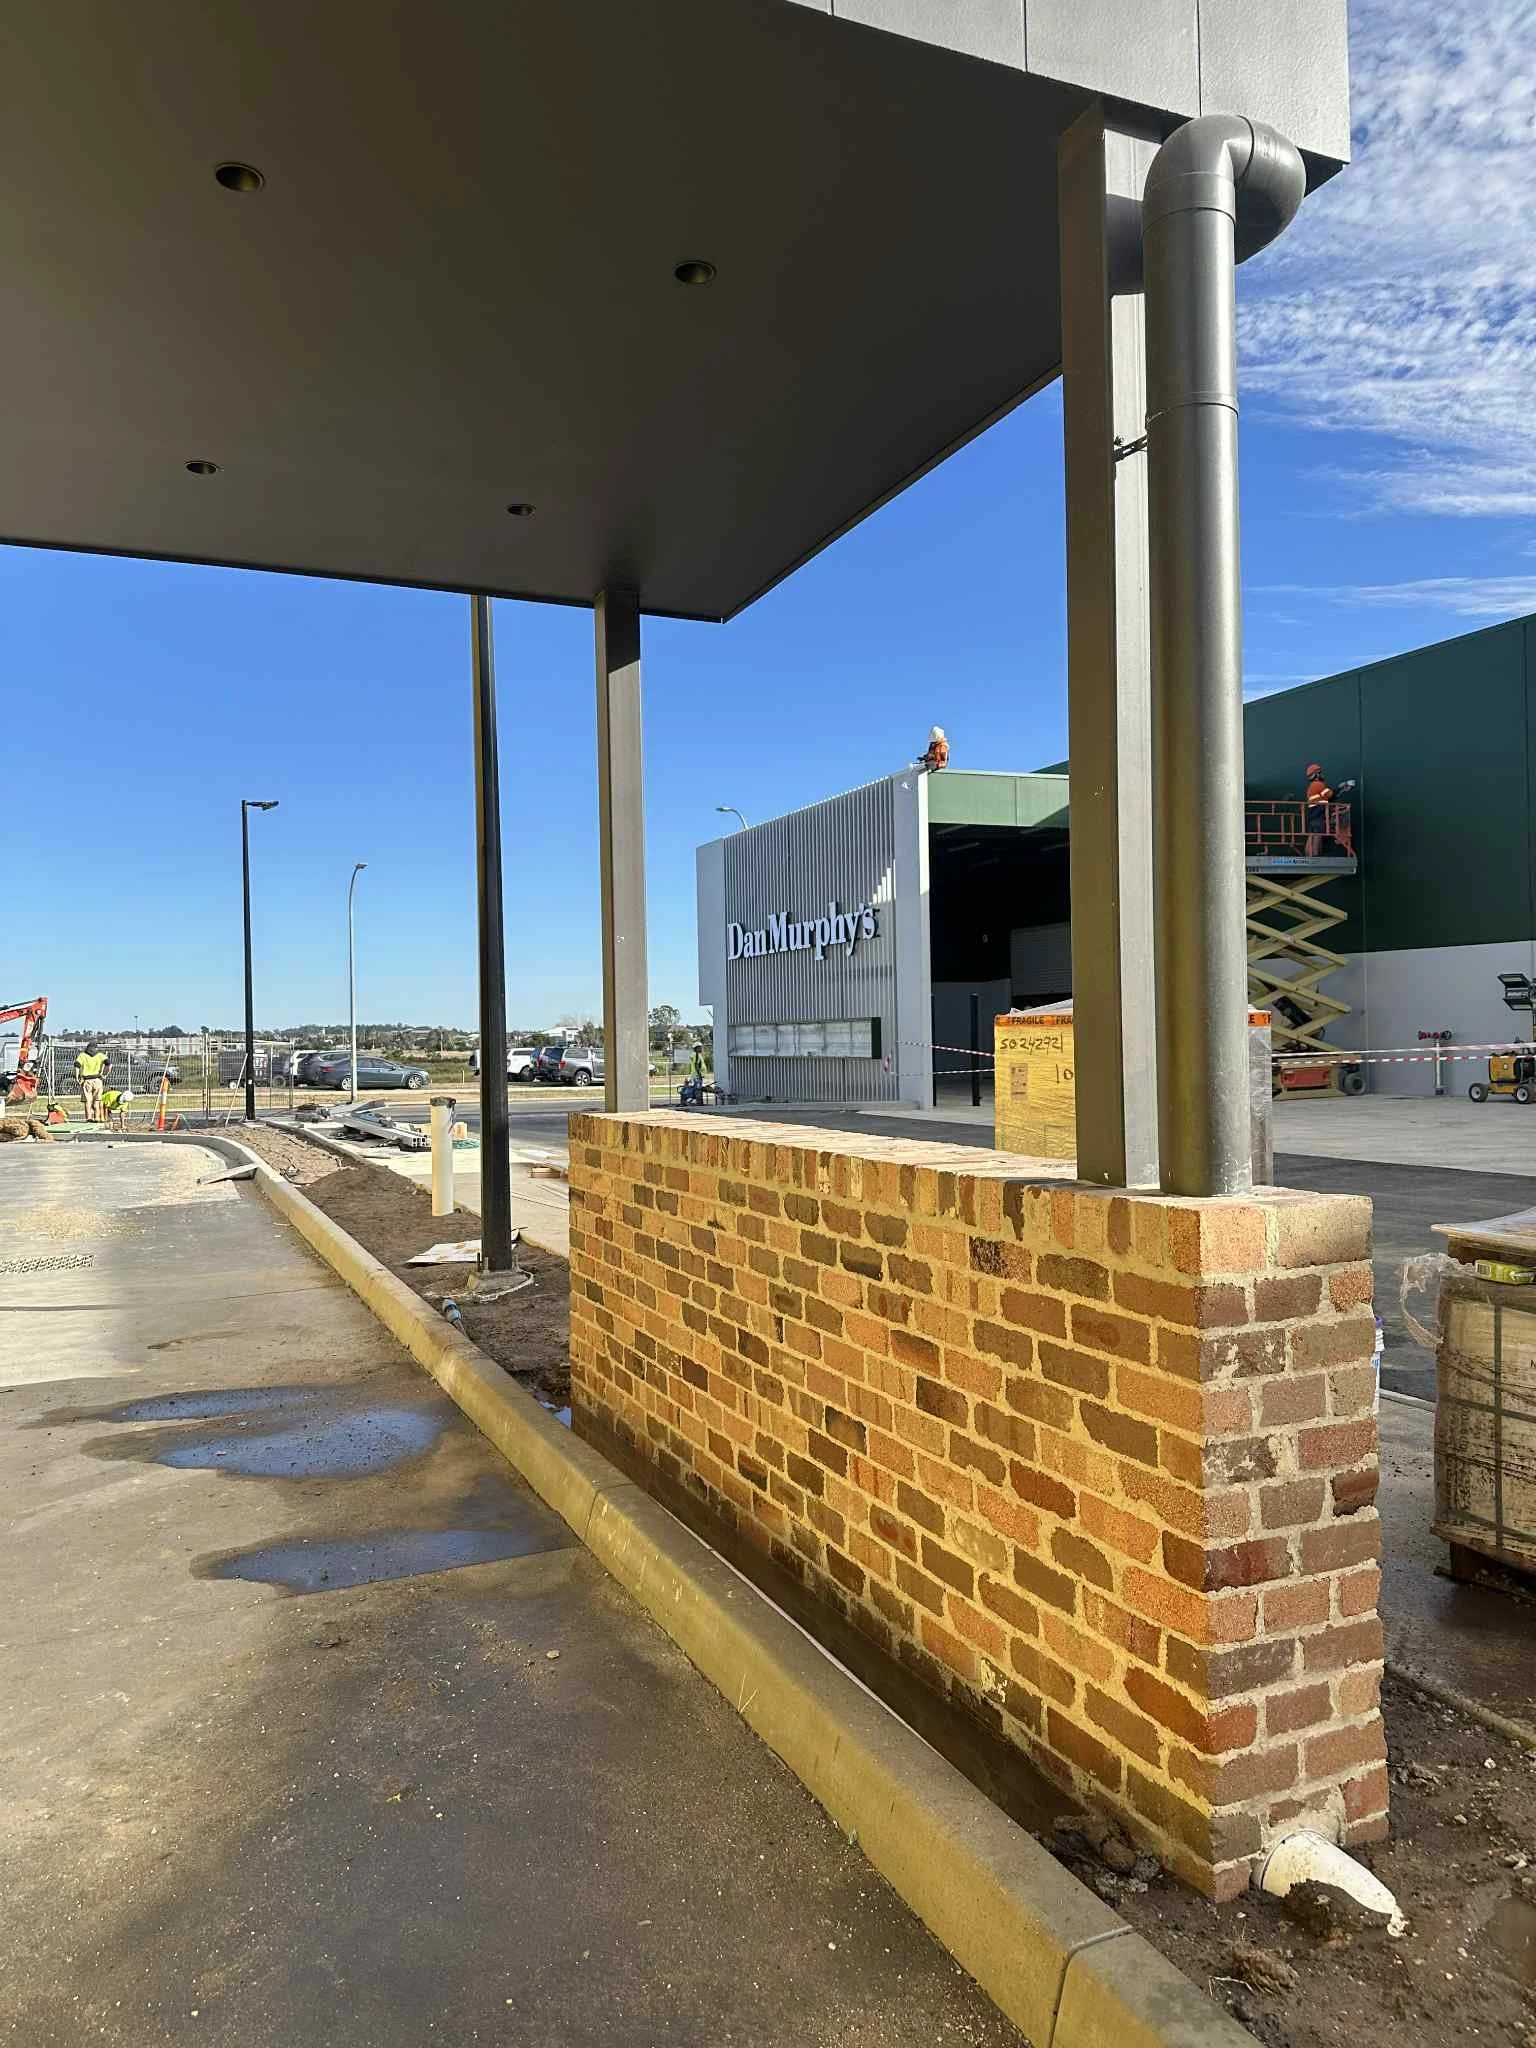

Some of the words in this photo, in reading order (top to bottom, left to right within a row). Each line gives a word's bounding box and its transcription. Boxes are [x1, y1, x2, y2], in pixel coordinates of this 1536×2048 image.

[727, 922, 770, 960] Dan
[768, 901, 877, 961] Murphy's
[1011, 1016, 1045, 1026] FRAGILE
